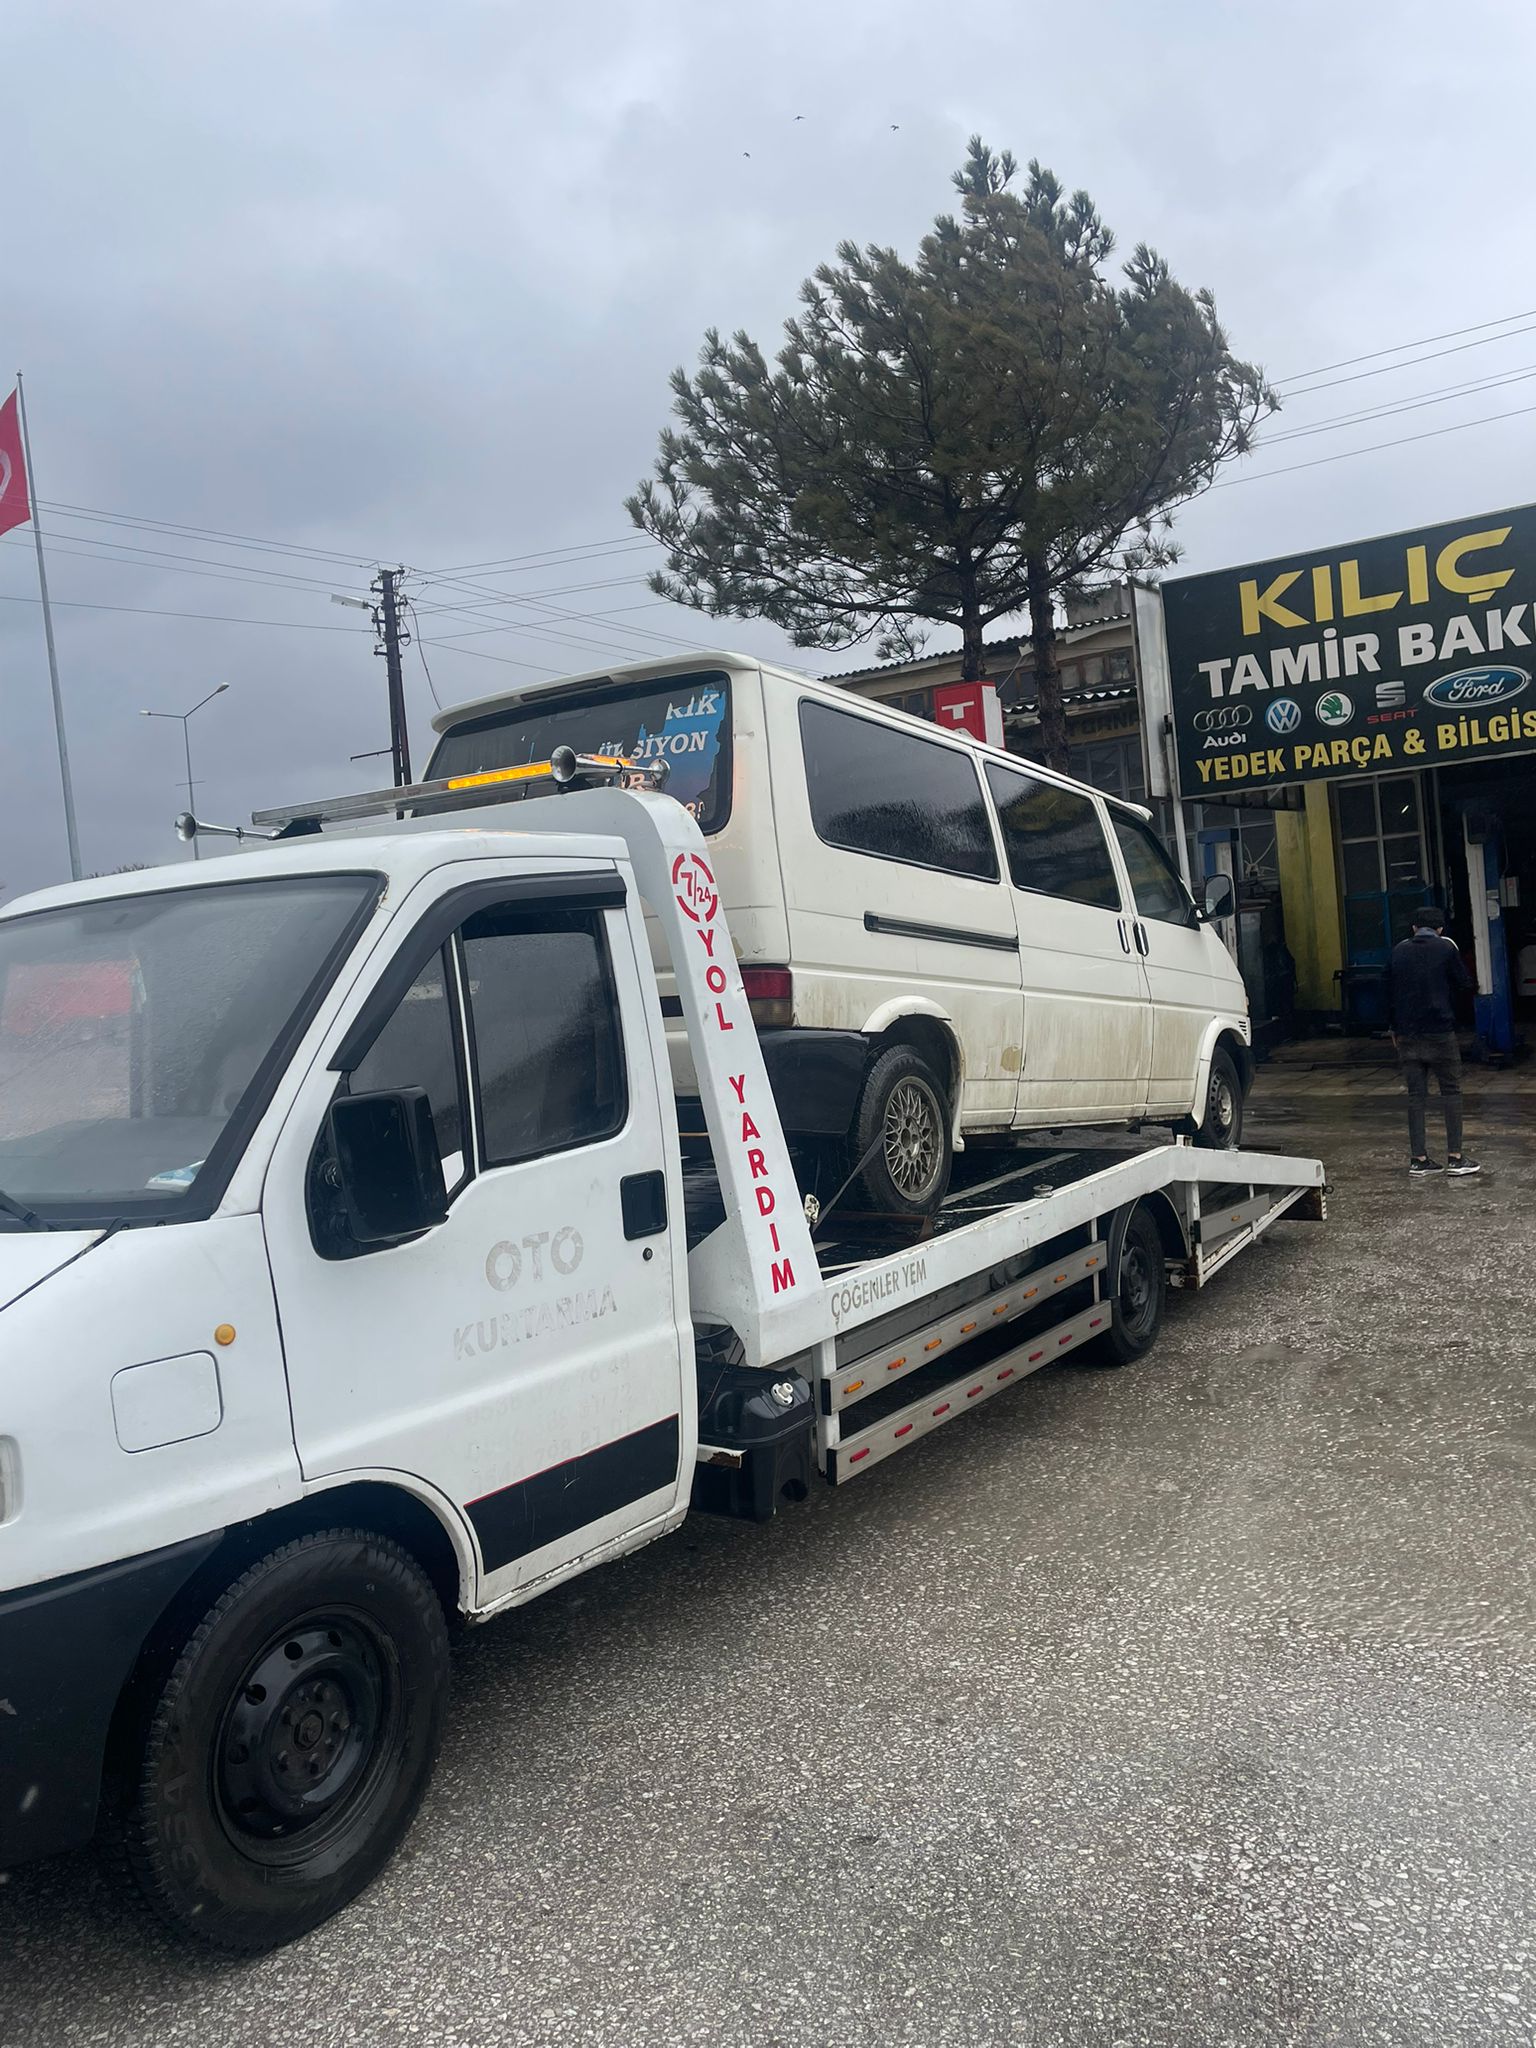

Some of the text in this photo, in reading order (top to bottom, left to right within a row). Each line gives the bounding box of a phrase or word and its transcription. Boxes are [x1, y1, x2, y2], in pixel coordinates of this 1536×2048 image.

[1239, 526, 1516, 636] KILIÇ
[1198, 601, 1536, 698] TAMİR BAK
[1448, 673, 1505, 701] Ford
[1203, 732, 1247, 749] Audi
[1366, 707, 1419, 725] SEAT
[1195, 748, 1286, 783] YEDEK
[1294, 733, 1392, 768] PARÇA
[1403, 728, 1426, 755] &
[697, 929, 796, 1294] YOL YARDIM
[485, 1226, 584, 1292] OTO
[902, 1258, 927, 1288] YEM
